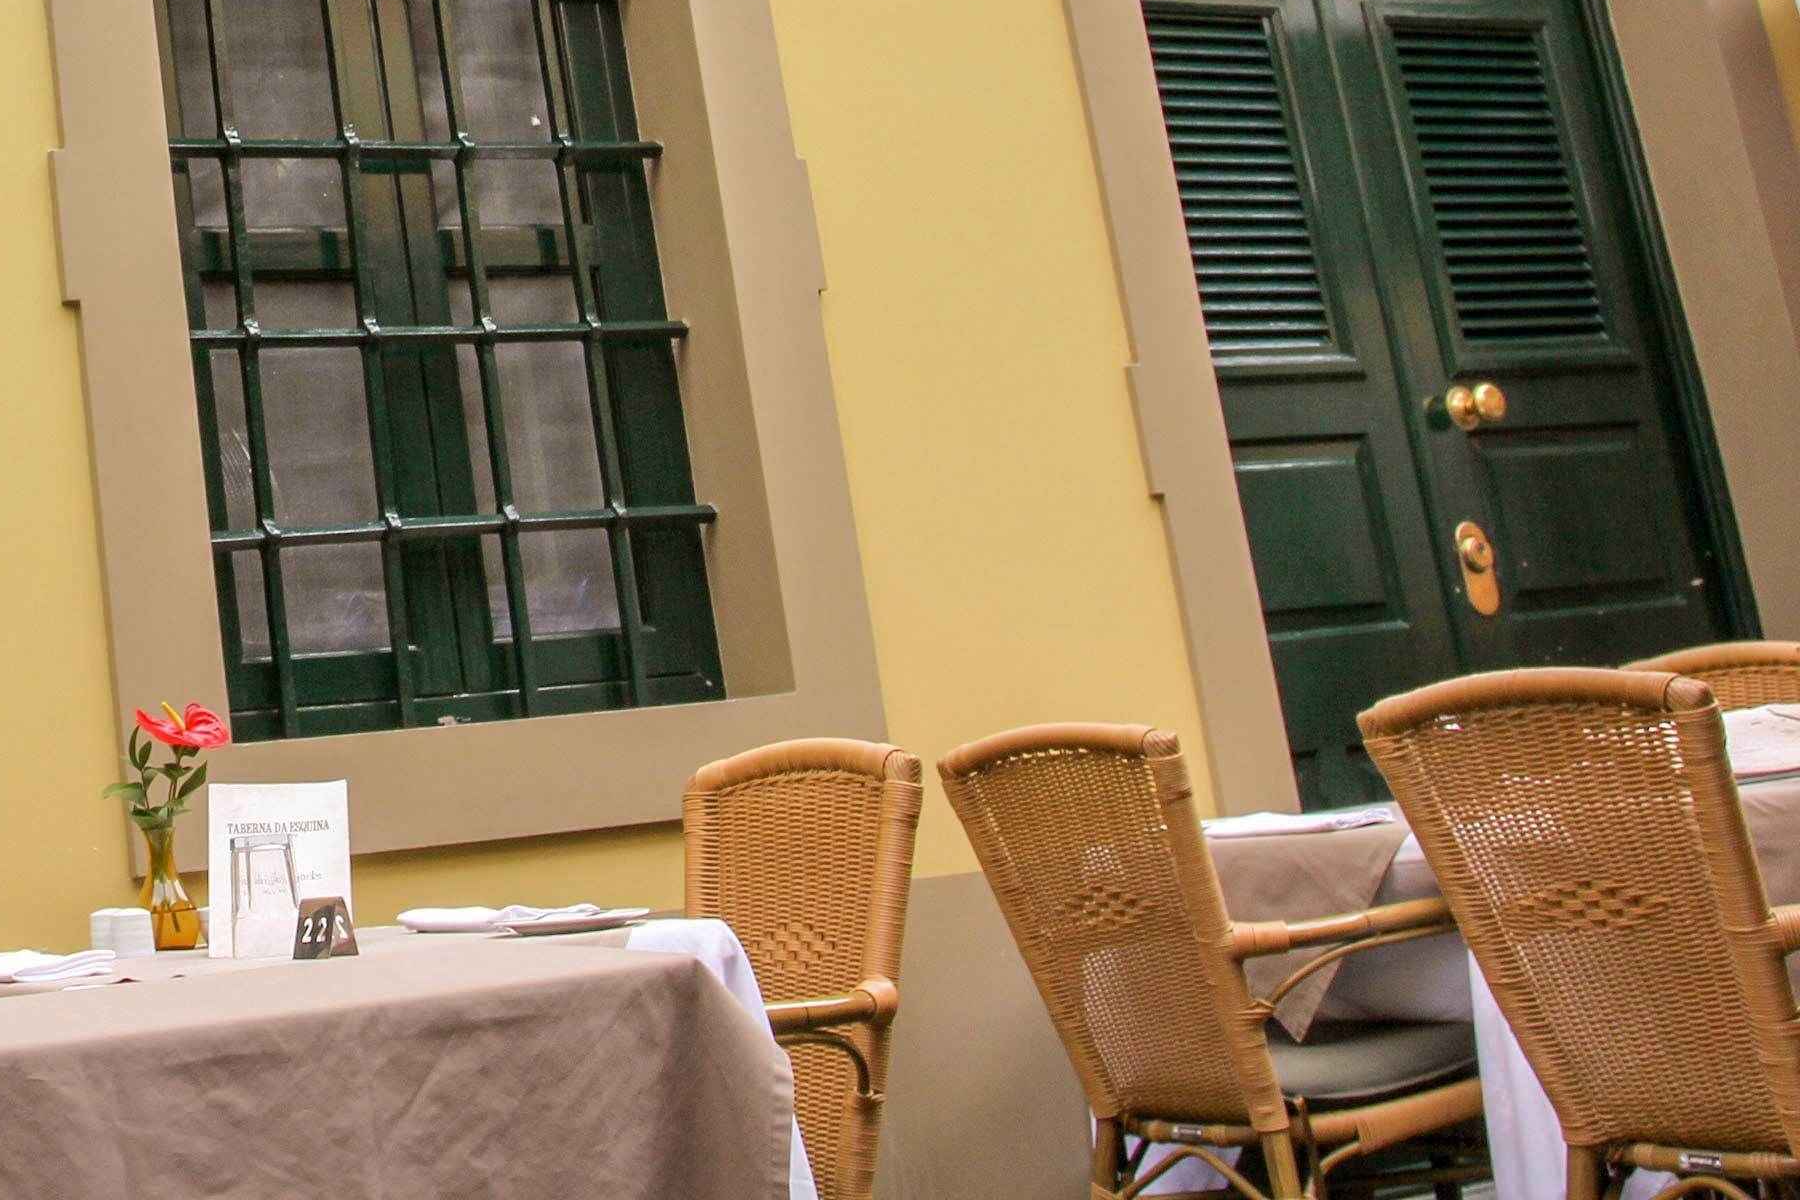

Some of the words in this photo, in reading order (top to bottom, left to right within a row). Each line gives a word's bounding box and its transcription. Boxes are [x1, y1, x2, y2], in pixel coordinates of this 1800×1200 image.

[227, 822, 272, 834] TABERNA
[274, 822, 288, 834] DA
[290, 819, 329, 833] ESQUINA
[301, 917, 327, 943] 22
